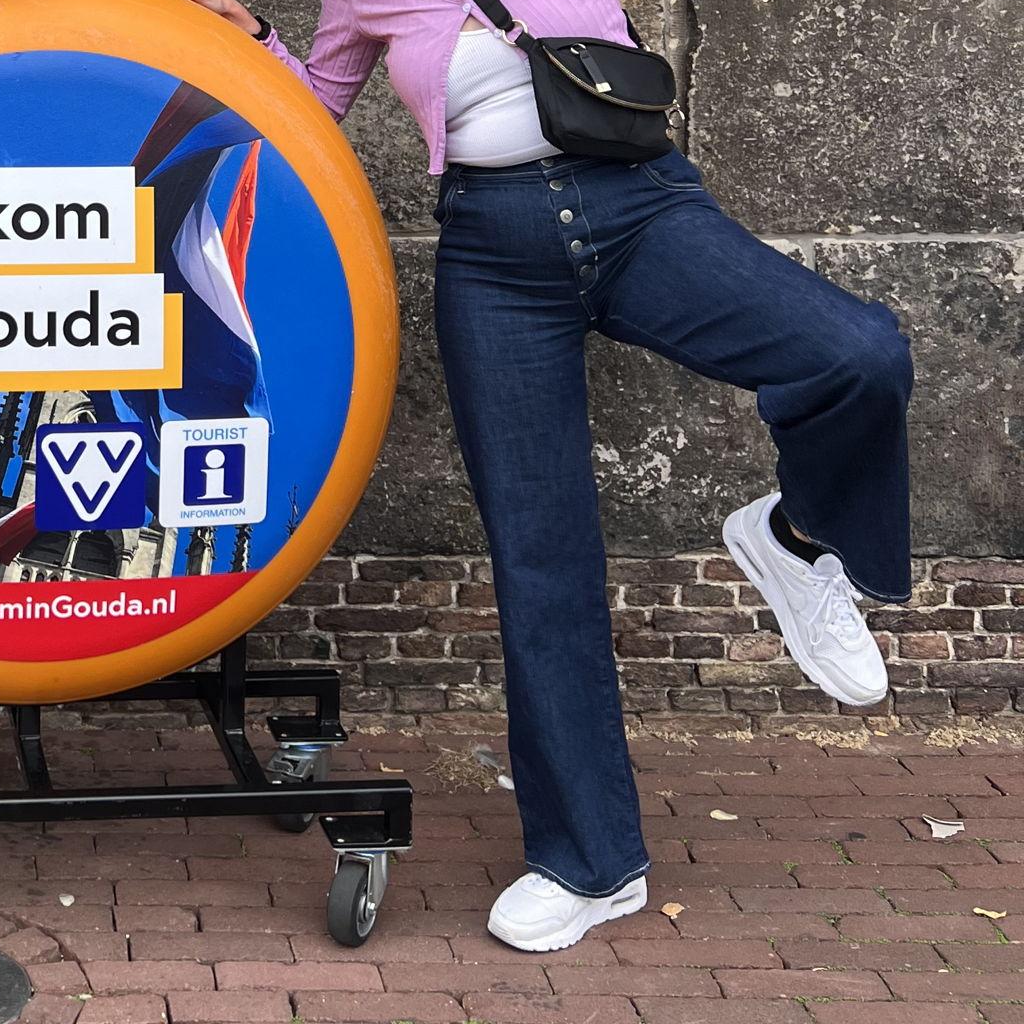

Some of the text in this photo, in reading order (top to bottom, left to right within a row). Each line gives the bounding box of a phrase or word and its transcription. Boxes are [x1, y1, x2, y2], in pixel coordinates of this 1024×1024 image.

[183, 427, 248, 441] TOURIST
[48, 440, 136, 514] VVV
[180, 507, 246, 519] INFORMATION
